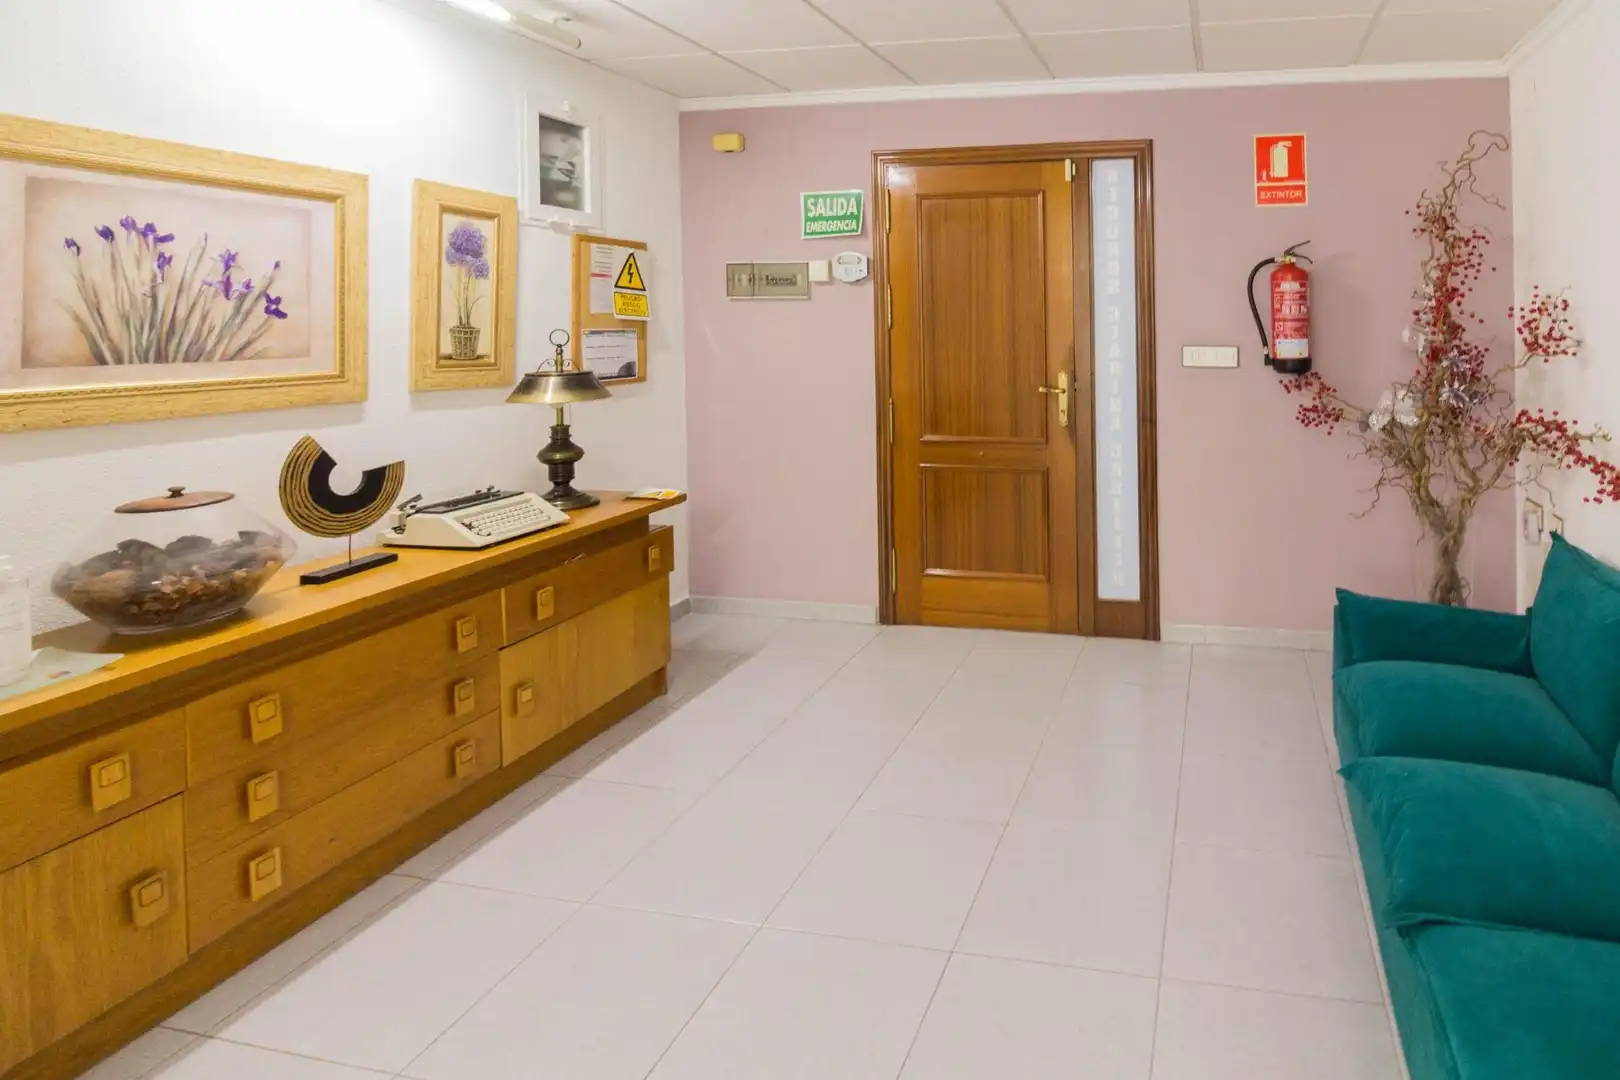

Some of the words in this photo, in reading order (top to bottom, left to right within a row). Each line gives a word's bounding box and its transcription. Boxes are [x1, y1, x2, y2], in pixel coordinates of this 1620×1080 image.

[1260, 190, 1302, 200] EXTINTOR
[807, 197, 858, 217] SALIDA
[806, 219, 857, 233] EMERGENCIA
